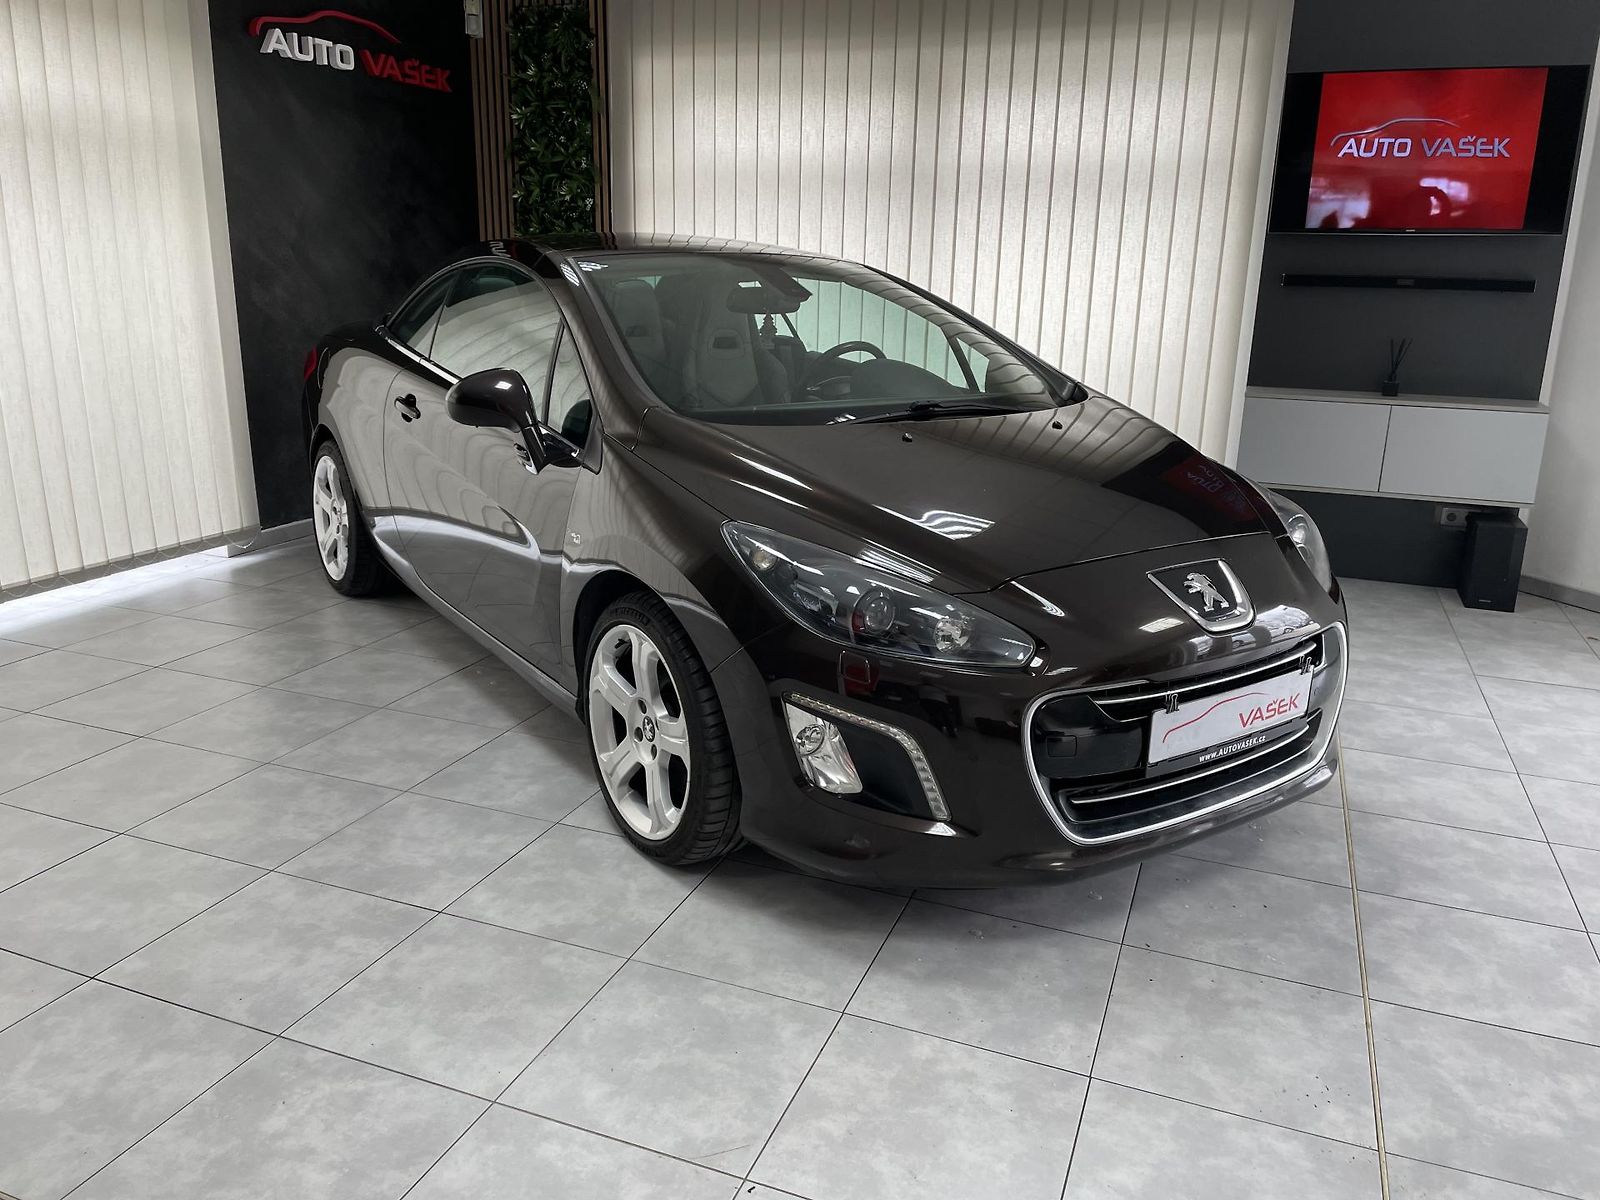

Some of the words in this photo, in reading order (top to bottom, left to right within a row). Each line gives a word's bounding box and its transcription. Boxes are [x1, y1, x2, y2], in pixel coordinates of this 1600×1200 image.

[260, 28, 355, 71] AUTO
[358, 50, 452, 92] VAŠEK
[1337, 137, 1412, 158] AUTO
[1421, 135, 1510, 158] VAŠEK
[1239, 693, 1300, 728] VAŠEK
